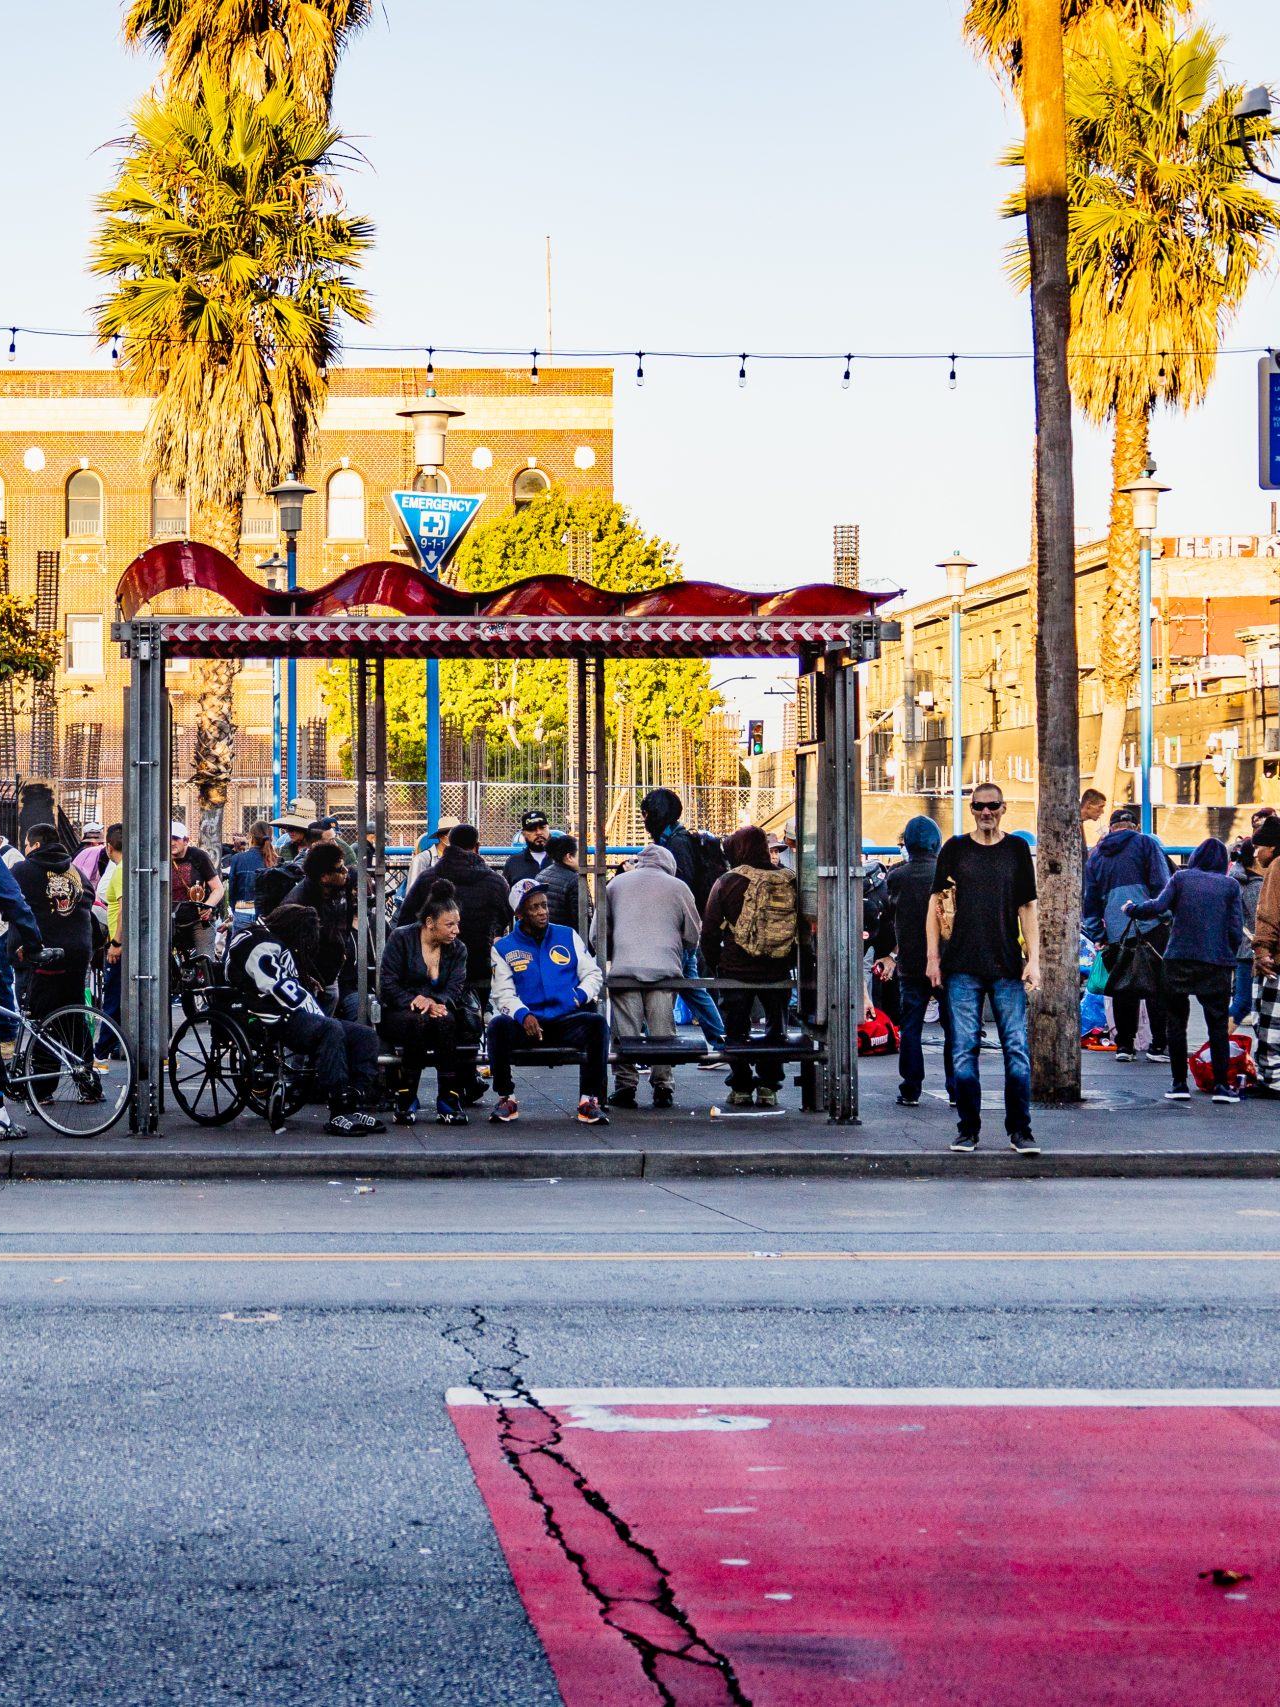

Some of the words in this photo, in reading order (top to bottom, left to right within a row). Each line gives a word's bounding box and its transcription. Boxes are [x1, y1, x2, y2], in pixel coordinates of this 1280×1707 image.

[401, 497, 473, 512] EMERGENCY
[420, 538, 446, 550] 9-1-1
[331, 1115, 354, 1130] AIR
